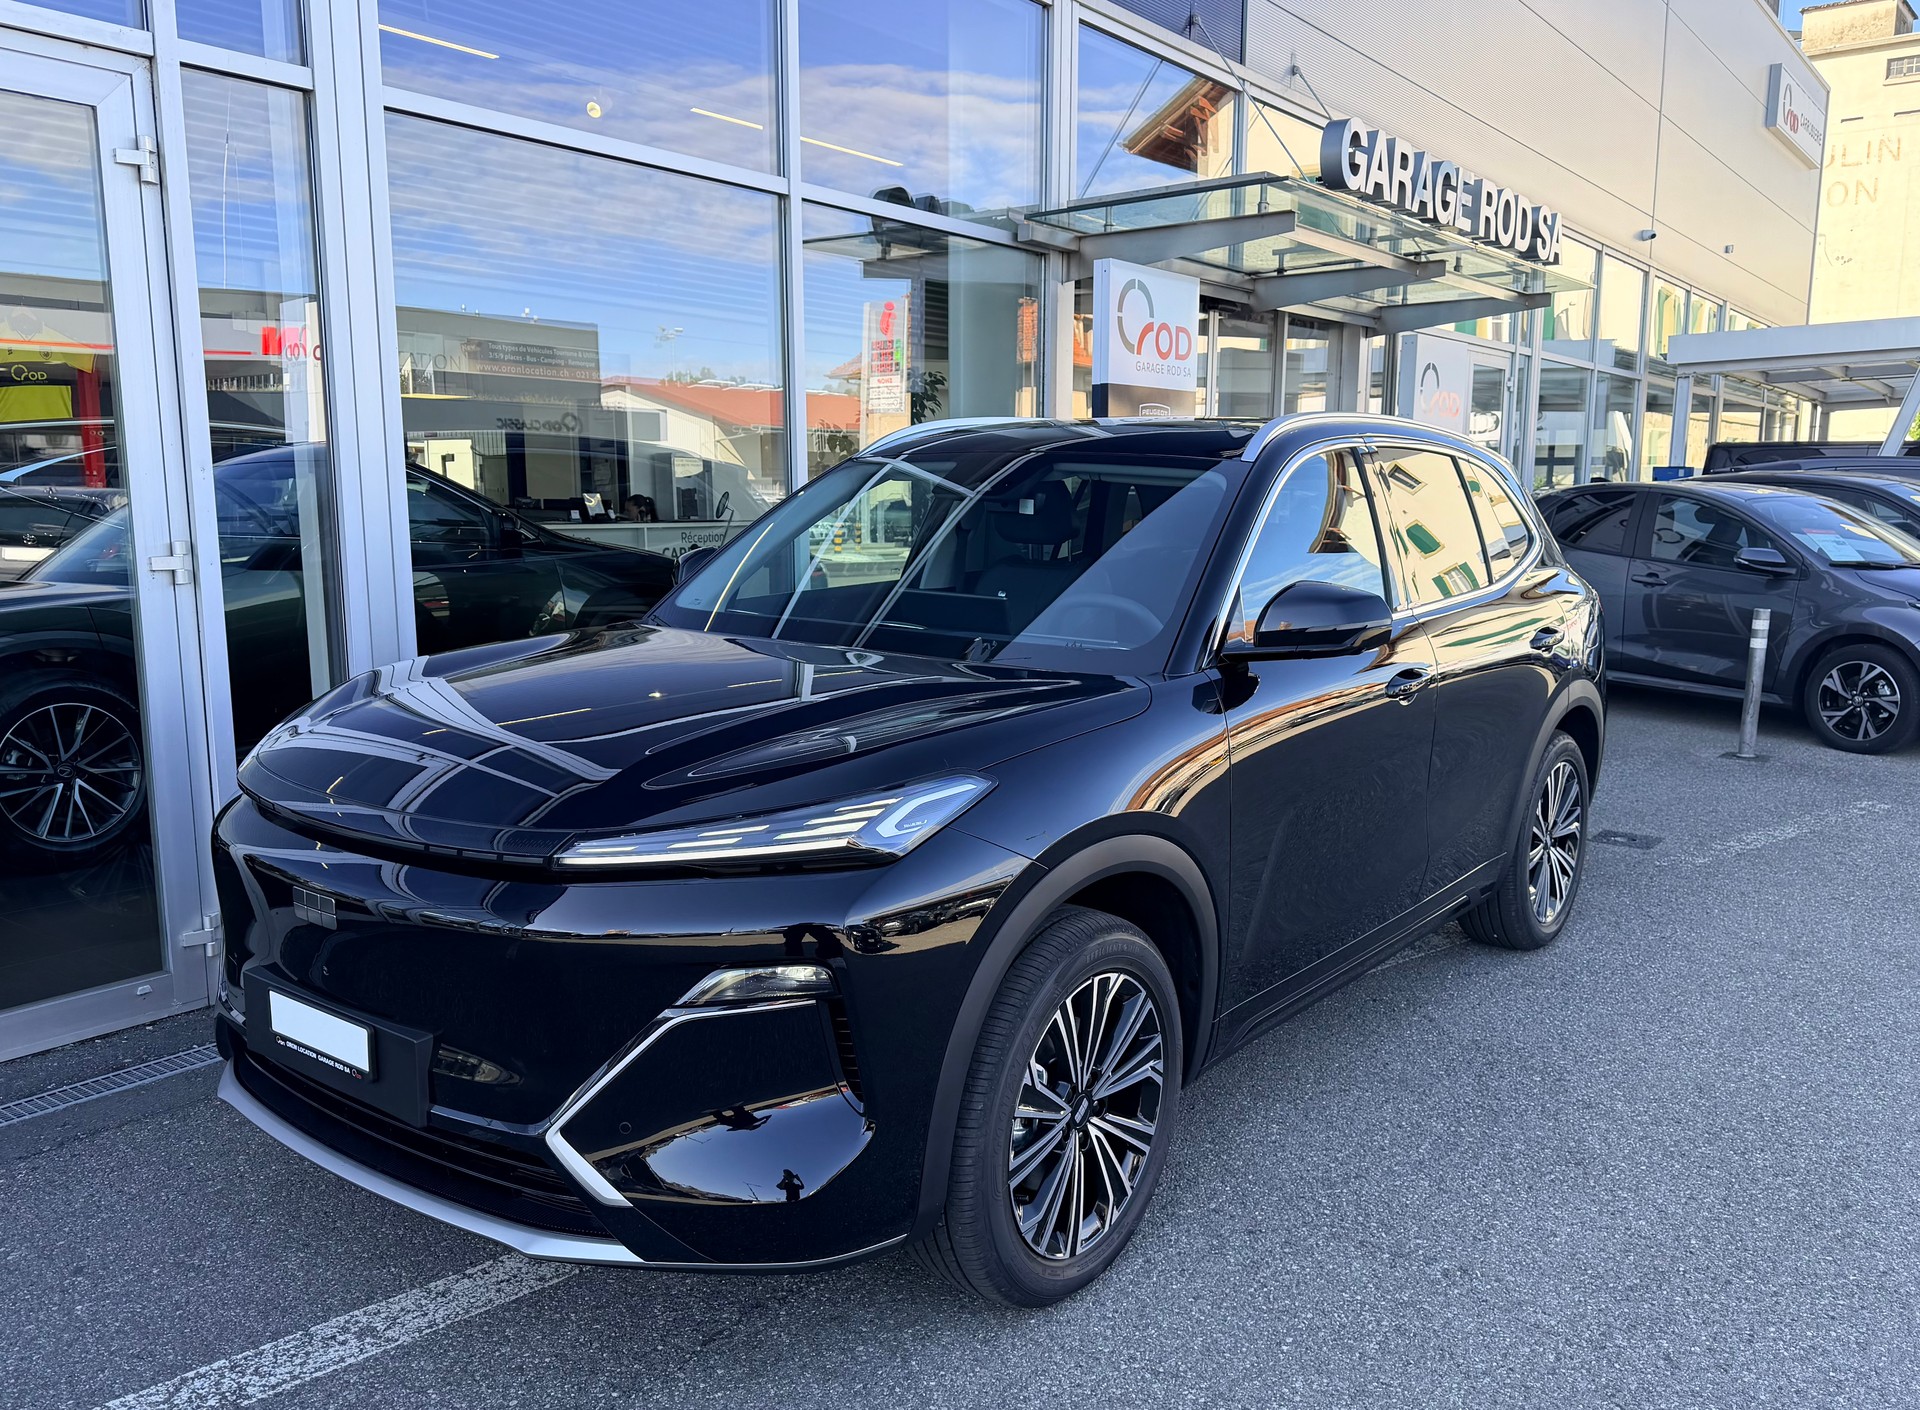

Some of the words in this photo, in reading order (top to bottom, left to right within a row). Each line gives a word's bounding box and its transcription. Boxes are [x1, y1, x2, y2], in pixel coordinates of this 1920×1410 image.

[1338, 117, 1475, 232] GARAGE
[1478, 178, 1532, 252] ROD
[1536, 204, 1563, 264] SA
[488, 342, 501, 350] Tous
[501, 344, 518, 353] types
[527, 346, 553, 356] Véhicules
[505, 353, 523, 362] places
[540, 356, 565, 367] Camping
[476, 363, 570, 377] www.oronlocation.ch
[575, 371, 590, 379] 021
[1135, 361, 1165, 375] GARAGE
[1166, 365, 1182, 377] ROD
[1183, 367, 1192, 378] SA
[1142, 408, 1169, 416] PEUGEOT
[681, 531, 725, 544] Réception
[298, 1045, 317, 1059] LOCATION
[318, 1055, 335, 1068] GARAGE
[335, 1062, 344, 1071] ROD
